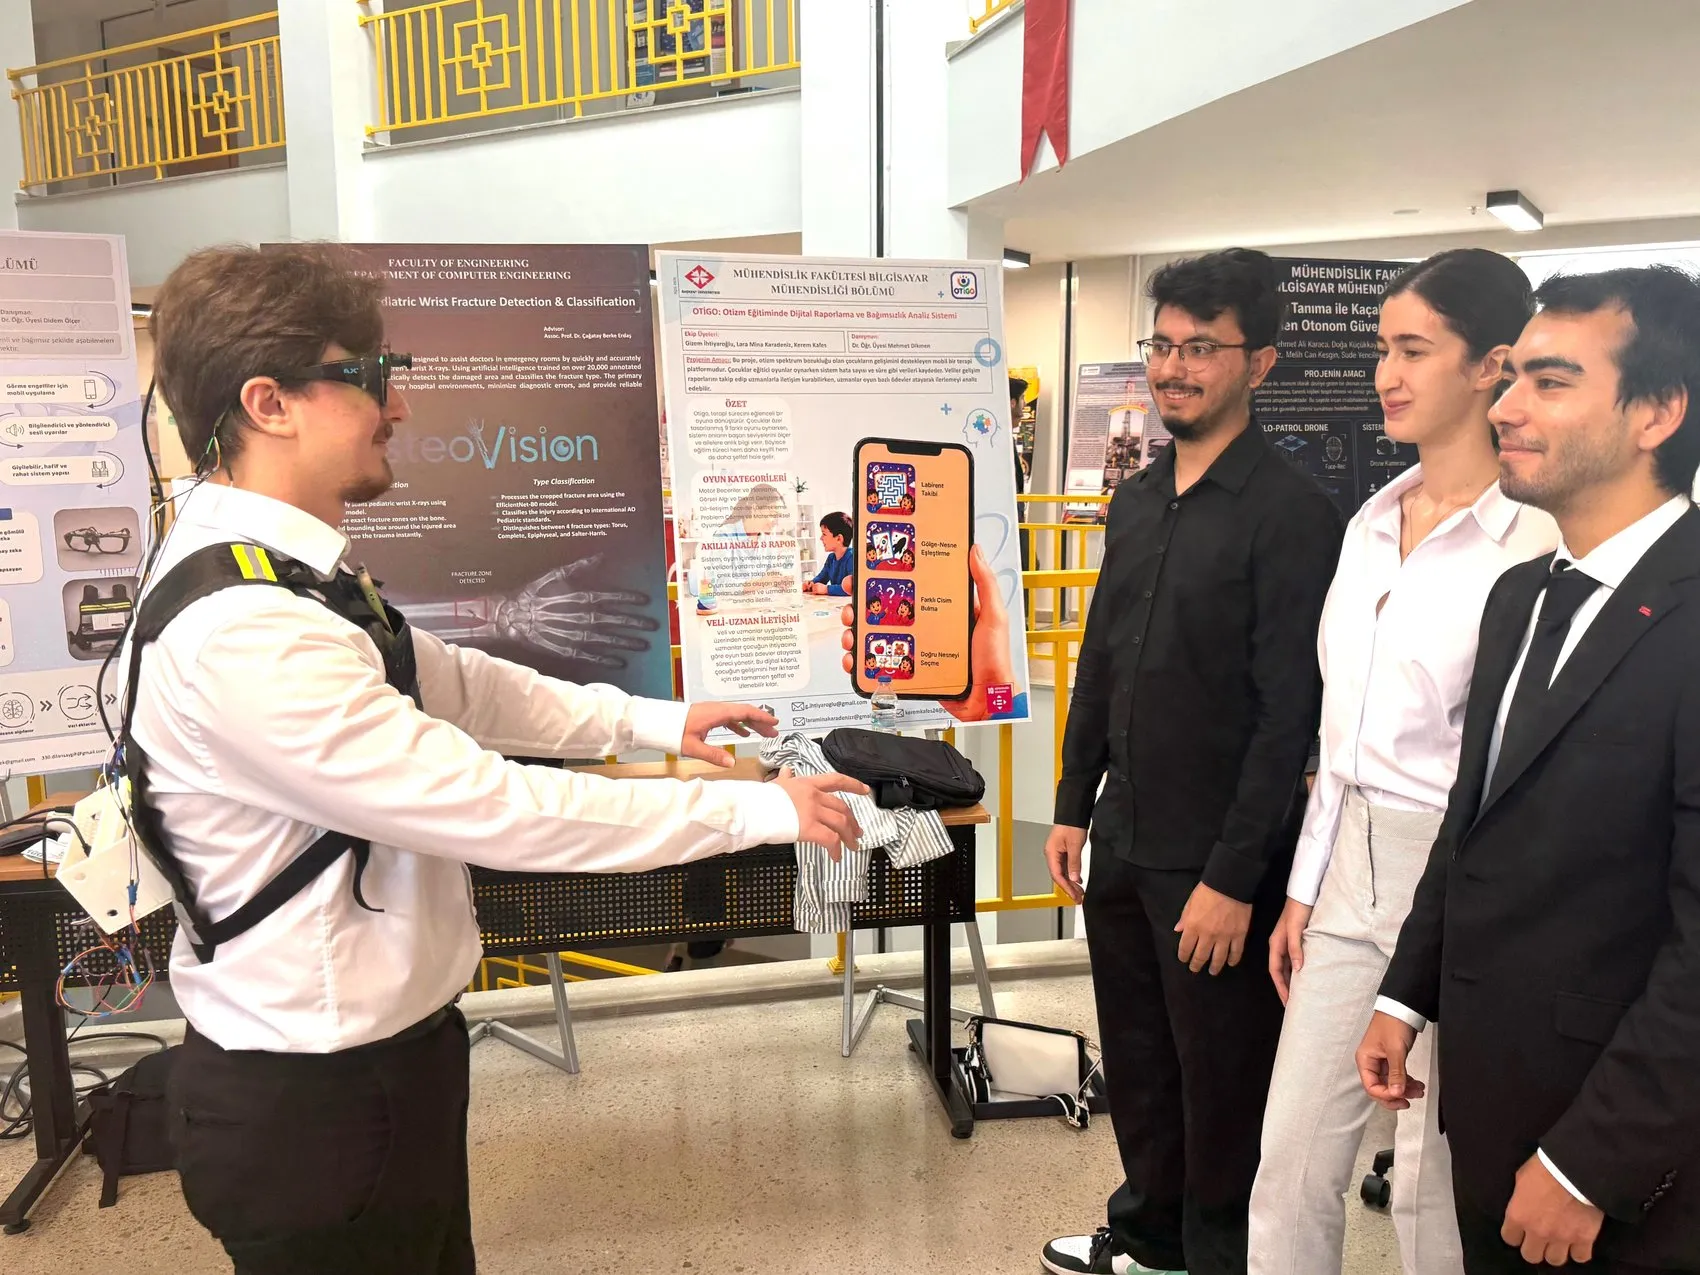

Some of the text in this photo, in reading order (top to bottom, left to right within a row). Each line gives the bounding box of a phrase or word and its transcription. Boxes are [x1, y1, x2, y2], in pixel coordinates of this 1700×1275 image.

[389, 259, 529, 267] FACULTY OF ENGINEERING
[422, 271, 436, 279] OF
[438, 271, 497, 279] COMPUTER
[500, 271, 571, 279] ENGINEERING
[733, 267, 928, 282] MÜHENDİSLİK FAKÜLTESİ BİLGİSAYAR
[1291, 264, 1372, 280] MÜHENDİSLİK
[771, 283, 895, 296] MÜHENDİSLİĞİ BÖLÜMÜ
[420, 298, 448, 306] Wrist
[452, 298, 496, 306] Fracture
[500, 297, 552, 306] Detection
[555, 297, 564, 306] &
[566, 297, 635, 306] Classification
[692, 306, 721, 316] OTİGO:
[748, 309, 788, 318] Eğitiminde
[790, 310, 812, 319] Dijital
[814, 310, 854, 319] Raporlama
[866, 311, 906, 320] Bağımsızlık
[1291, 302, 1332, 315] Tanıma
[1335, 303, 1348, 315] ile
[1301, 320, 1346, 332] Otonom
[572, 355, 594, 363] quickly
[609, 355, 641, 363] accurately
[1304, 368, 1366, 378] PROJENİN AMACI
[725, 399, 747, 408] ÖZET
[1264, 424, 1329, 432] LO-PATROL DRONE
[388, 424, 598, 468] steoVision
[728, 472, 787, 483] KATEGORİLERİ
[729, 540, 759, 550] ANALİZ
[921, 541, 958, 550] Gölge-Nesne
[937, 597, 952, 605] Cisim
[761, 614, 800, 626] İLETİŞİMİ
[920, 651, 960, 660] Doğru Nesneyi
[921, 660, 940, 668] Seçme
